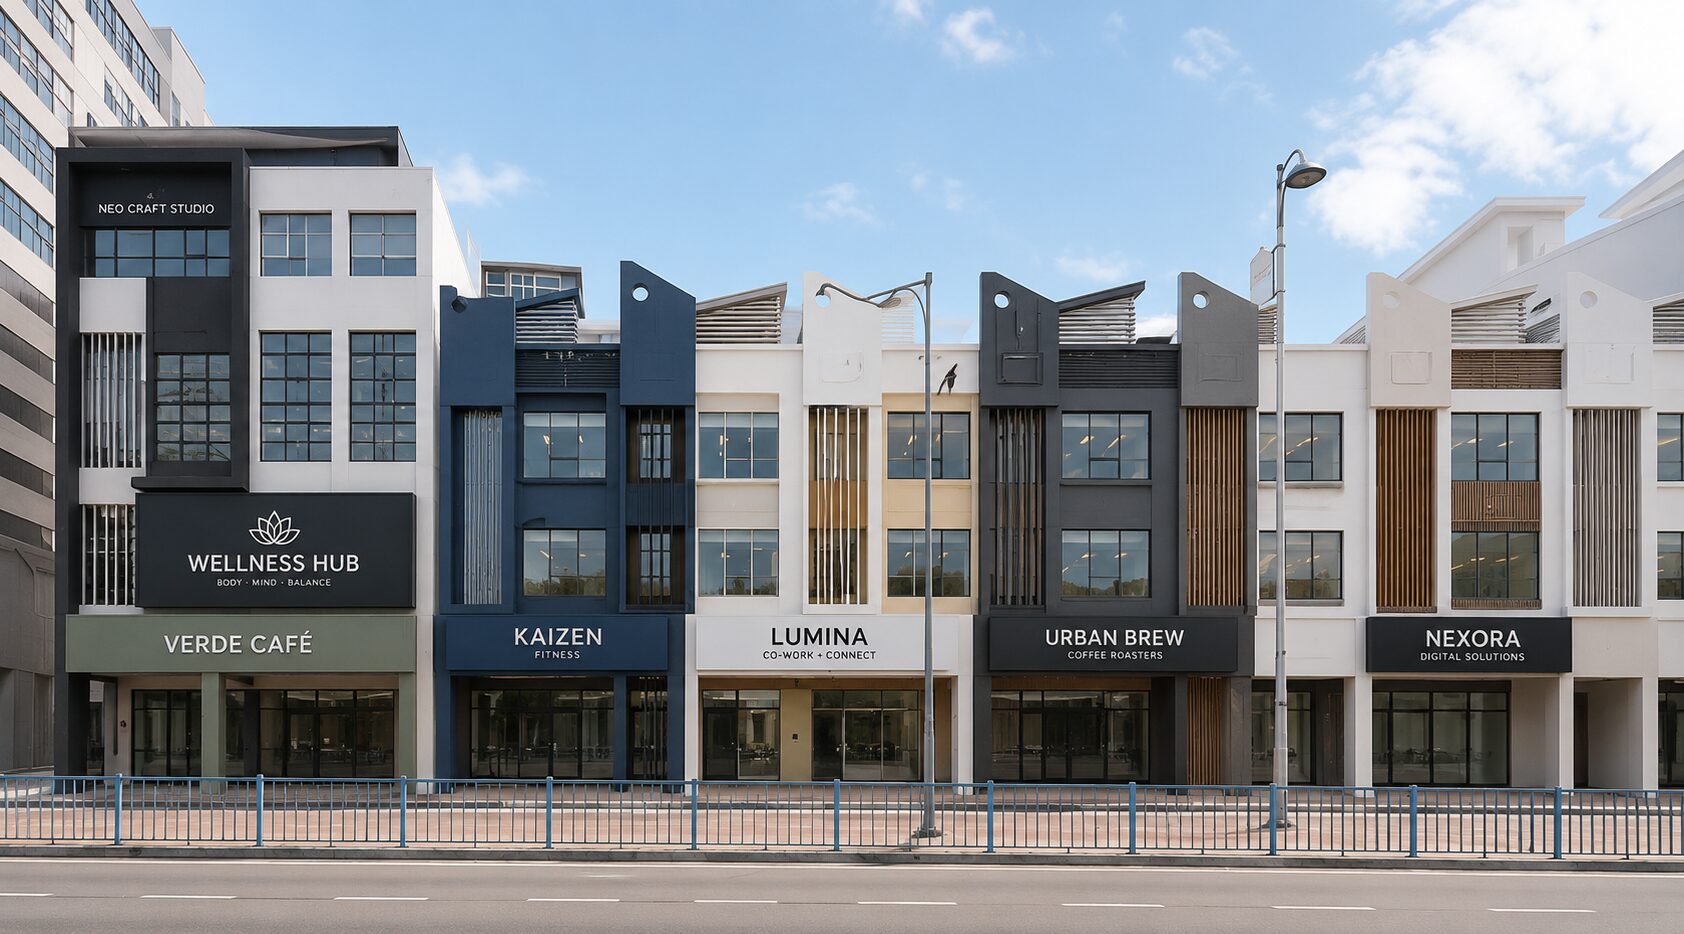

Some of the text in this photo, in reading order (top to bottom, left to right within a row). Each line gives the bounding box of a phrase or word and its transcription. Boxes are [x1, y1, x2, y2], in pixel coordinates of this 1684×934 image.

[98, 203, 215, 214] NEO CRAFT STUDIO
[187, 554, 360, 572] WELLNESS HUB
[217, 578, 243, 587] BODY
[252, 578, 277, 587] MIND
[287, 578, 331, 587] BALANCE
[163, 630, 313, 654] VERDE CAFÉ
[514, 627, 602, 646] KAIZEN
[771, 627, 869, 646] LUMINA
[1045, 629, 1185, 646] URBAN BREW
[1427, 629, 1521, 648] NEXORA
[534, 650, 580, 660] FITNESS
[762, 650, 814, 660] CO-WORK
[826, 650, 876, 660] CONNECT
[1067, 650, 1163, 660] COFFEE ROASTERS
[1420, 652, 1525, 662] DIGITAL SOLUTIONS
